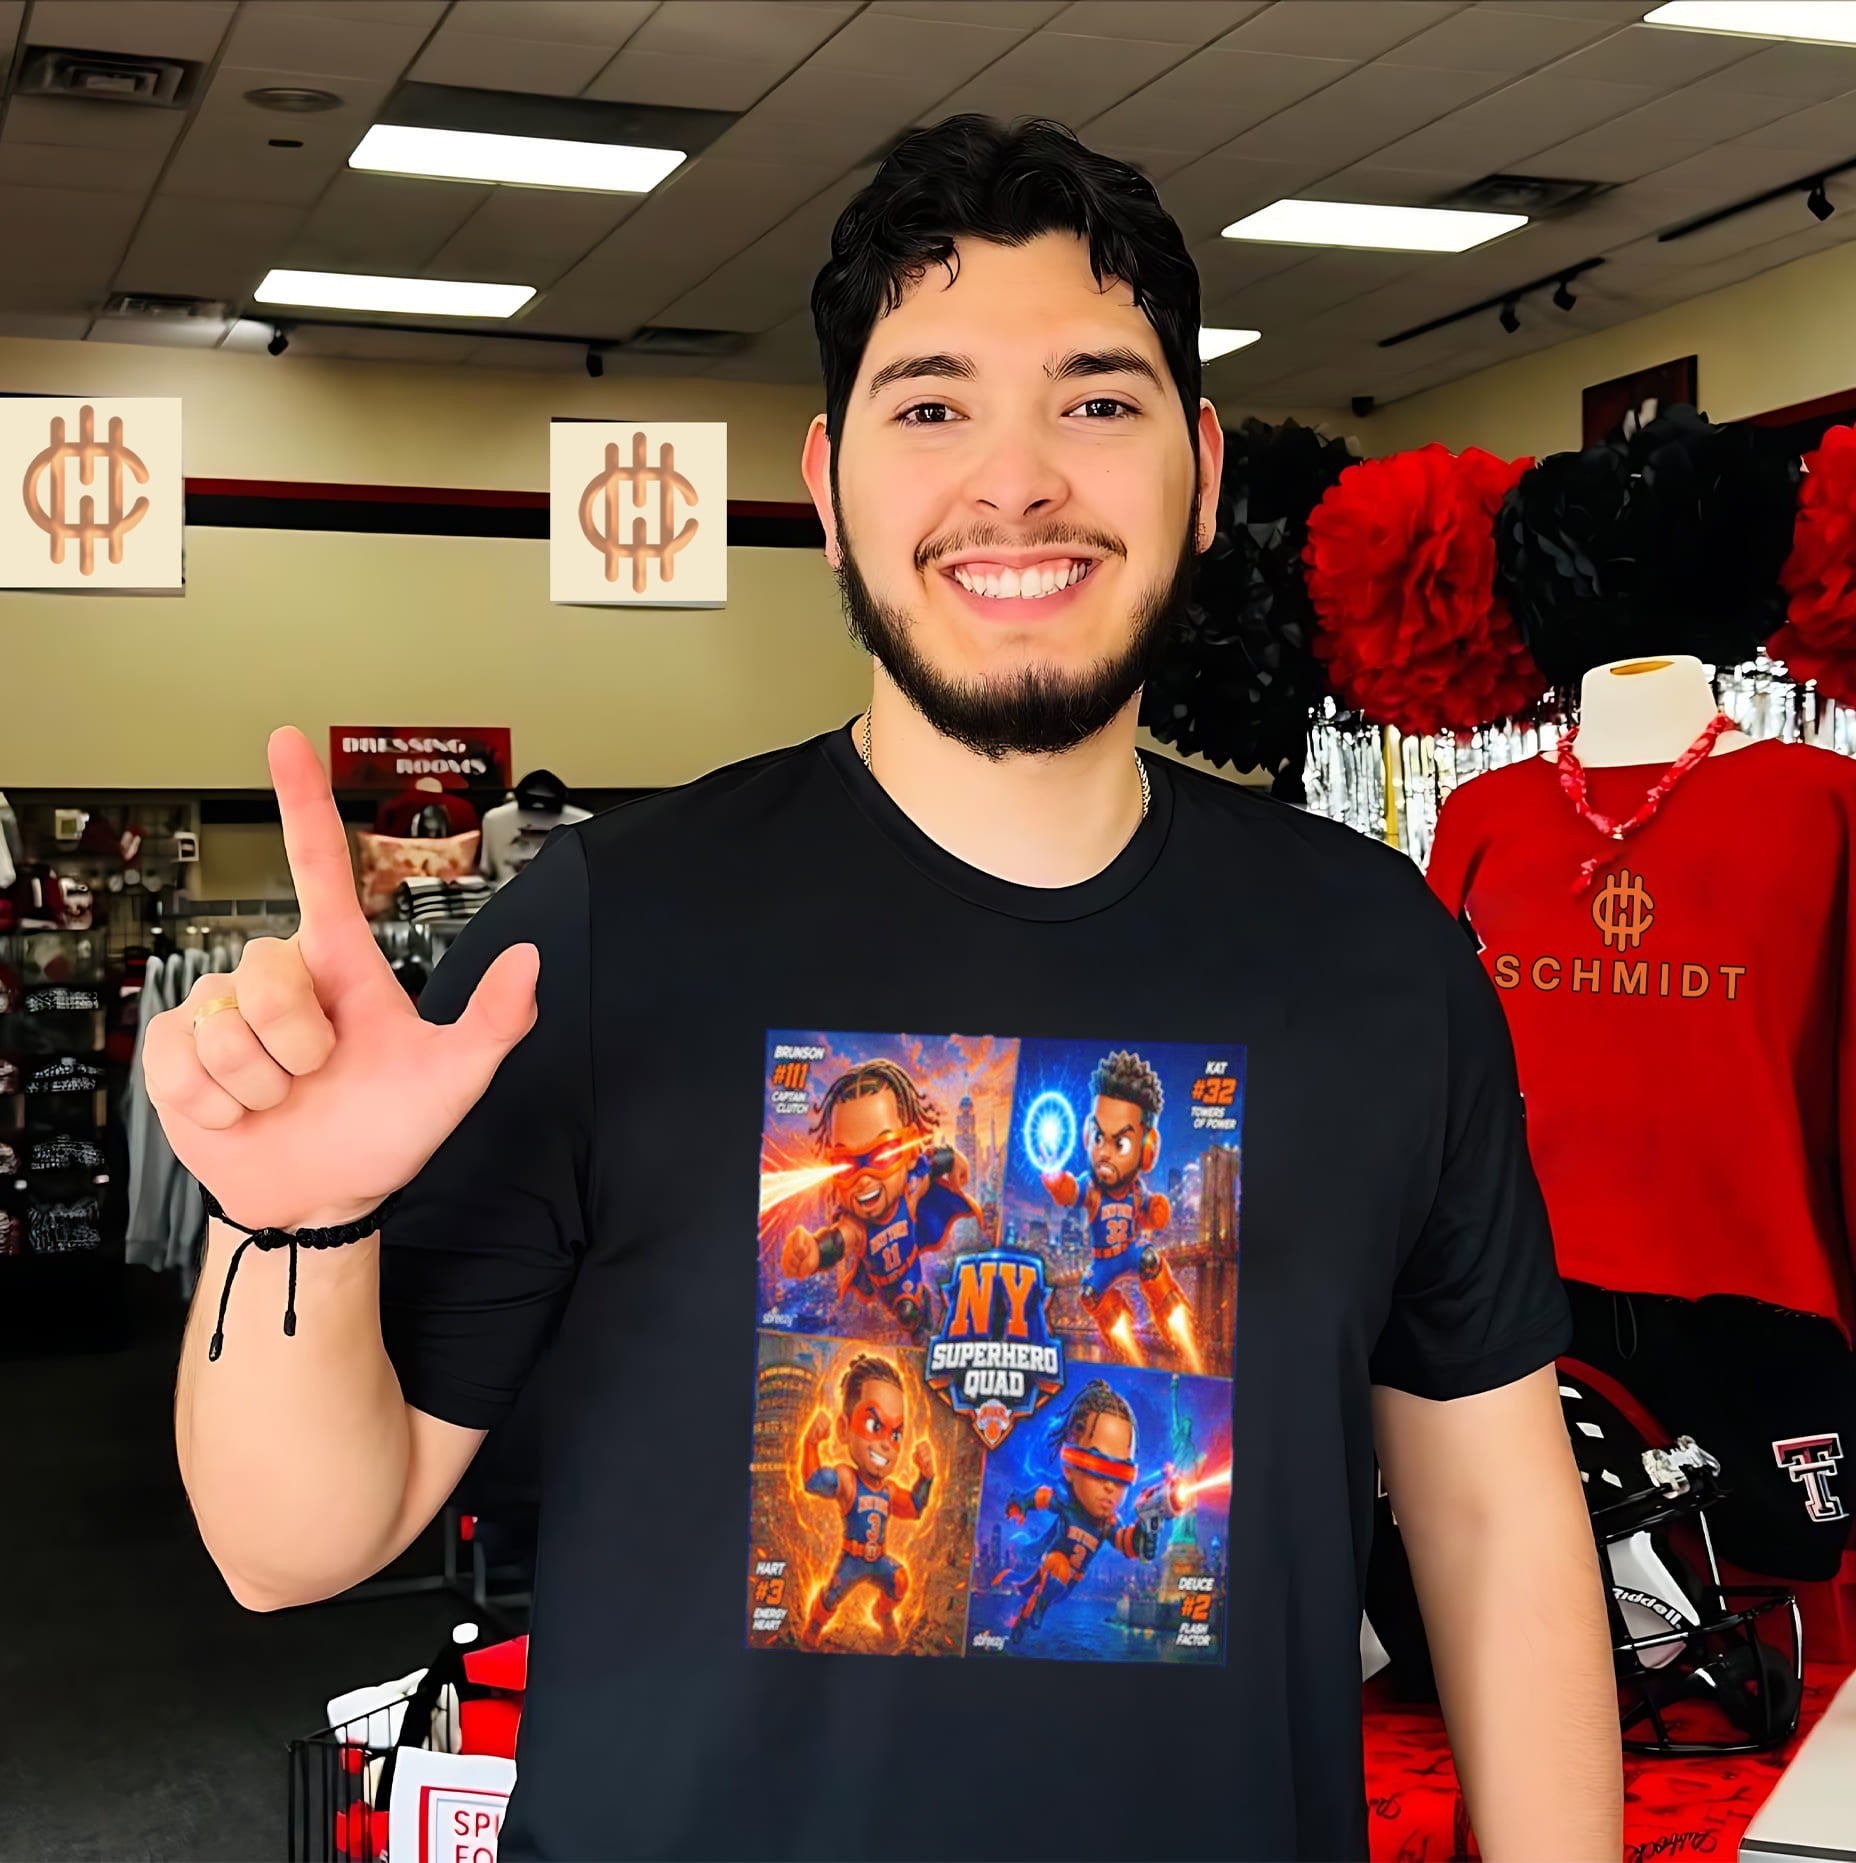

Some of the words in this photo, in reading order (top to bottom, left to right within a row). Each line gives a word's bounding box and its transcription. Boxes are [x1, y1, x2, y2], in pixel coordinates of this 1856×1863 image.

[1493, 954, 1747, 1000] SCHMIDT
[773, 1045, 826, 1060] BRUNSON
[1205, 1061, 1229, 1075] KAT
[771, 1090, 808, 1103] CAPTAIN
[1190, 1077, 1238, 1106] #32
[775, 1103, 810, 1115] CLUTCH
[1190, 1105, 1227, 1118] TOWERS
[1193, 1118, 1207, 1130] OF
[1205, 1118, 1238, 1131] POWER
[949, 1261, 1038, 1337] NY
[930, 1341, 1060, 1376] SUPERHERO
[962, 1369, 1025, 1399] QUAD
[755, 1561, 787, 1576] HART
[754, 1578, 786, 1605] #3
[1177, 1576, 1216, 1592] DEUCE
[752, 1607, 788, 1620] ENERGY
[1180, 1593, 1212, 1621] #2
[751, 1619, 782, 1632] HEART
[1178, 1622, 1210, 1635] FLASH
[1174, 1633, 1212, 1647] FACTOR
